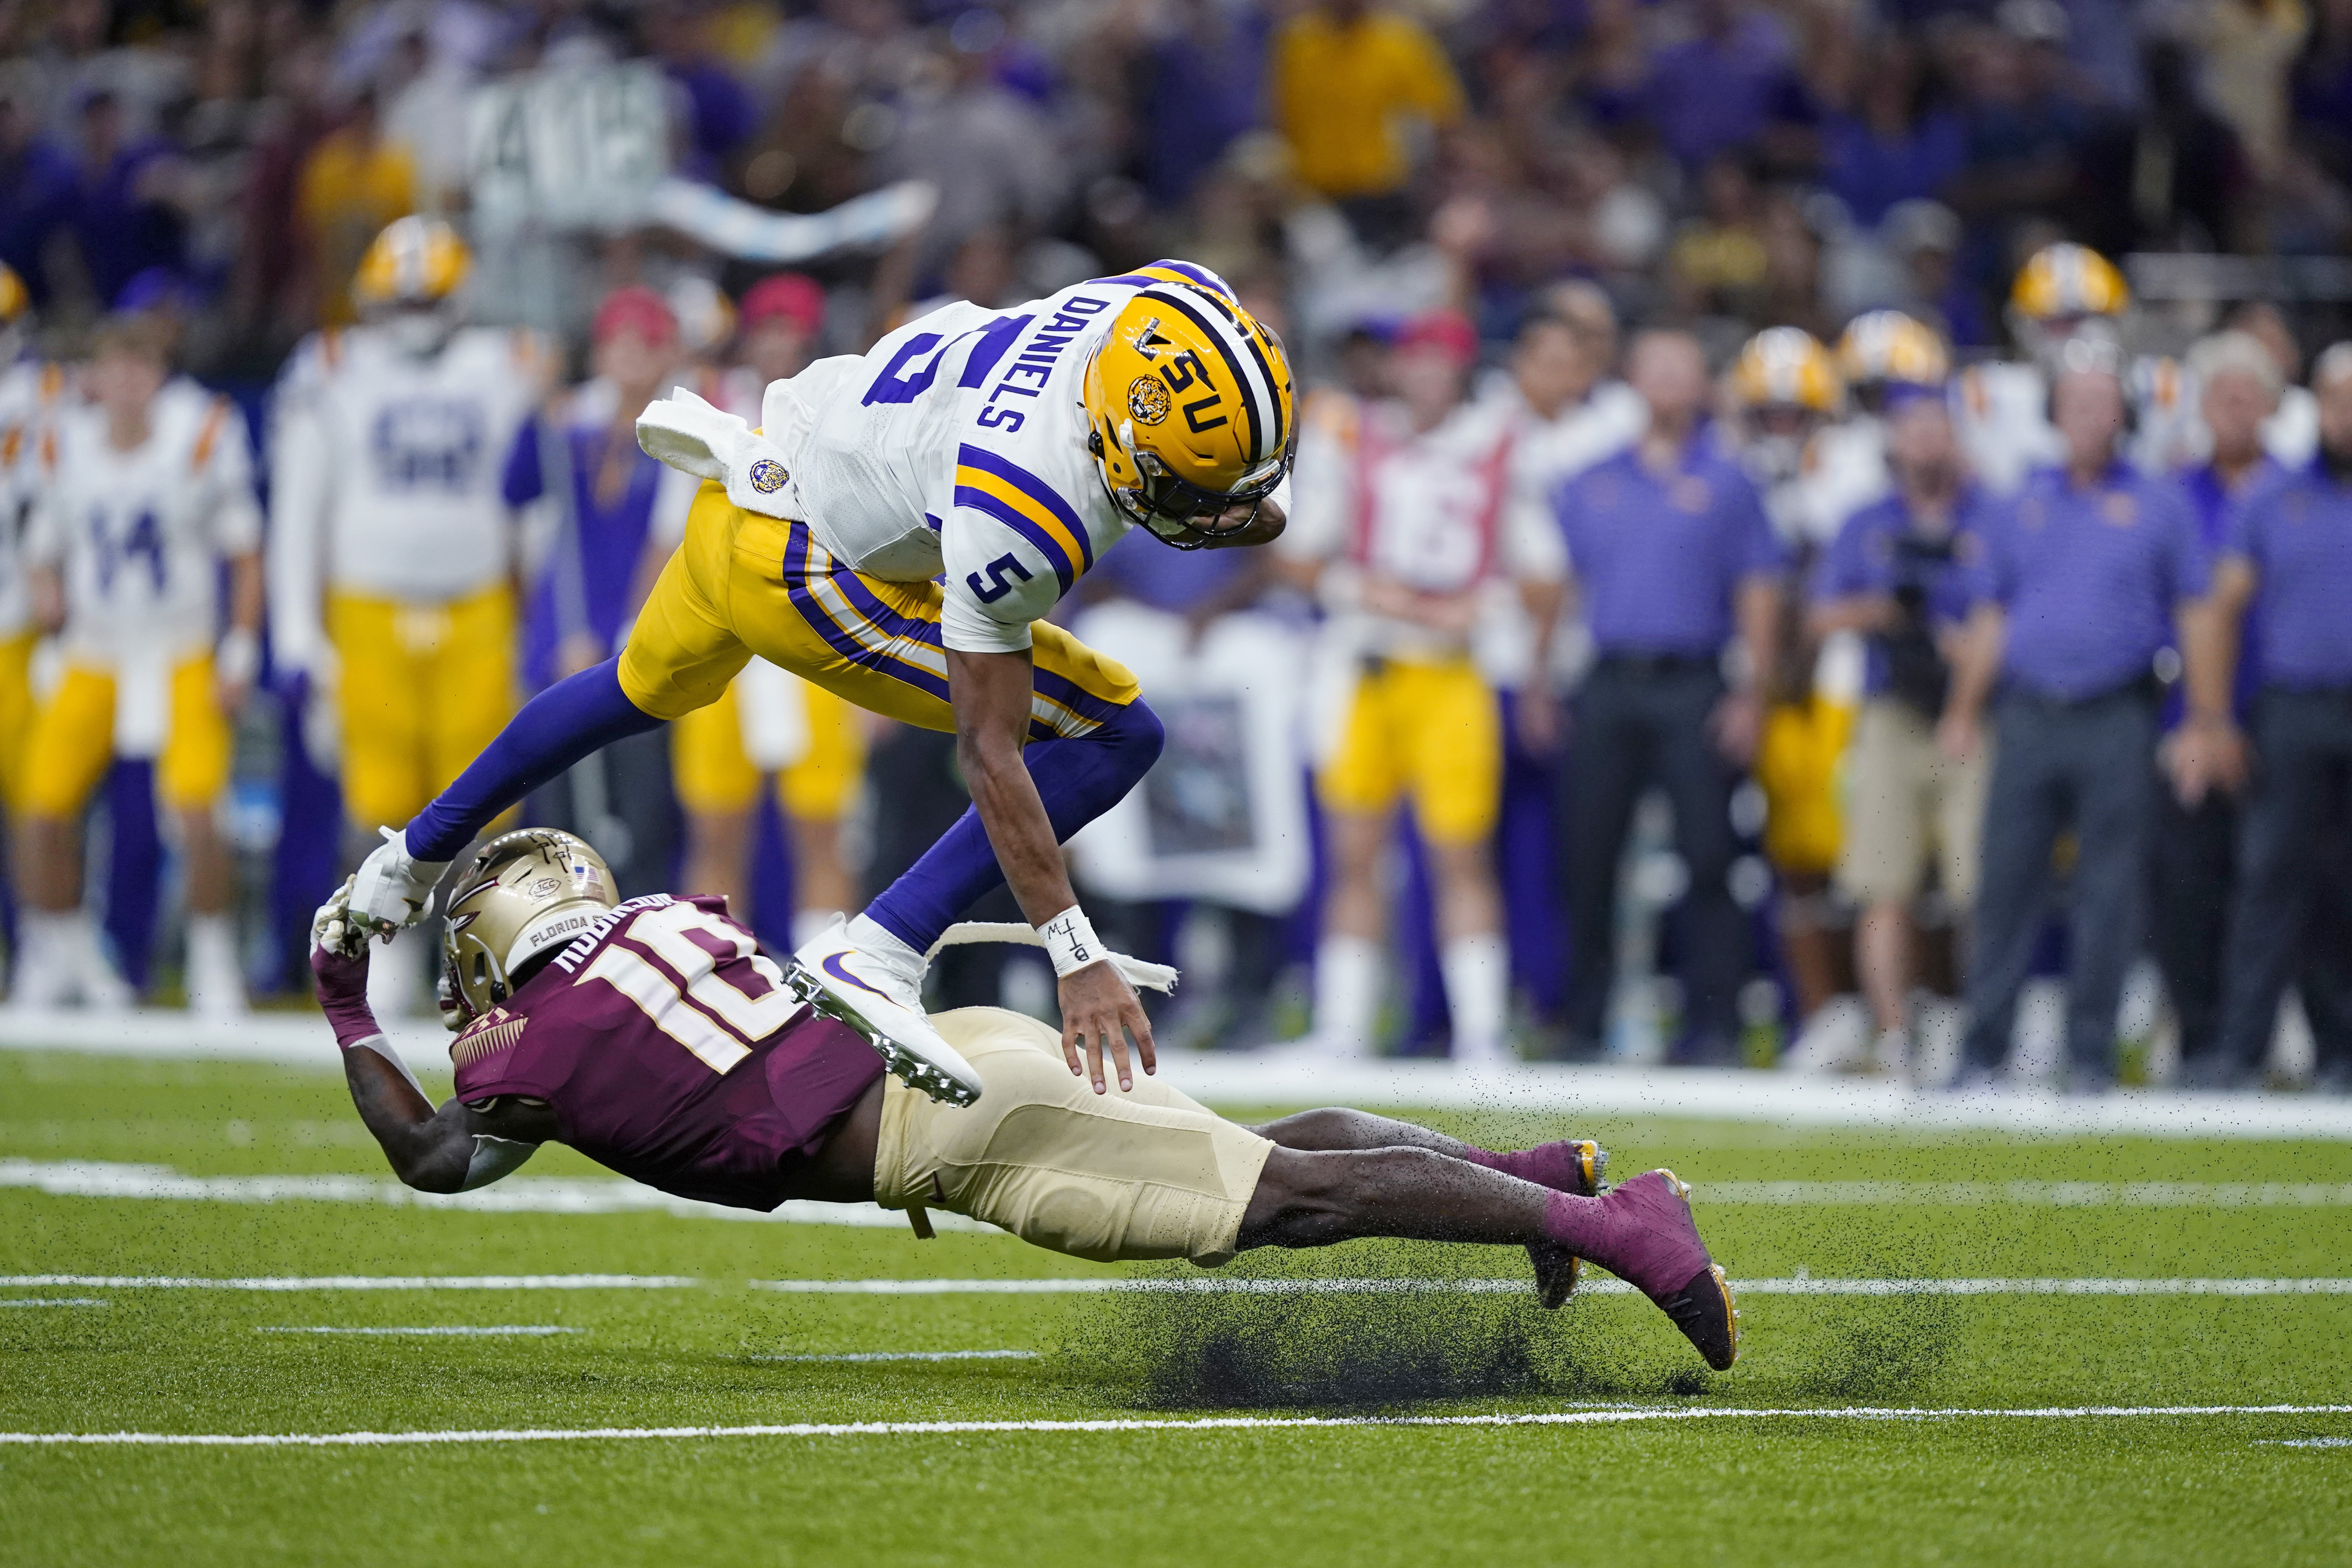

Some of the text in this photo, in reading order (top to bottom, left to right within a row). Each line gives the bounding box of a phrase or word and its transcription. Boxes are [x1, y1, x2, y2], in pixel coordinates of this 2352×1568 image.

[860, 314, 1037, 407] 5
[976, 296, 1111, 433] DANIELS
[1133, 317, 1228, 434] LSU
[966, 551, 1034, 604] 5
[529, 915, 588, 947] FLORIDA
[572, 901, 809, 1075] 10
